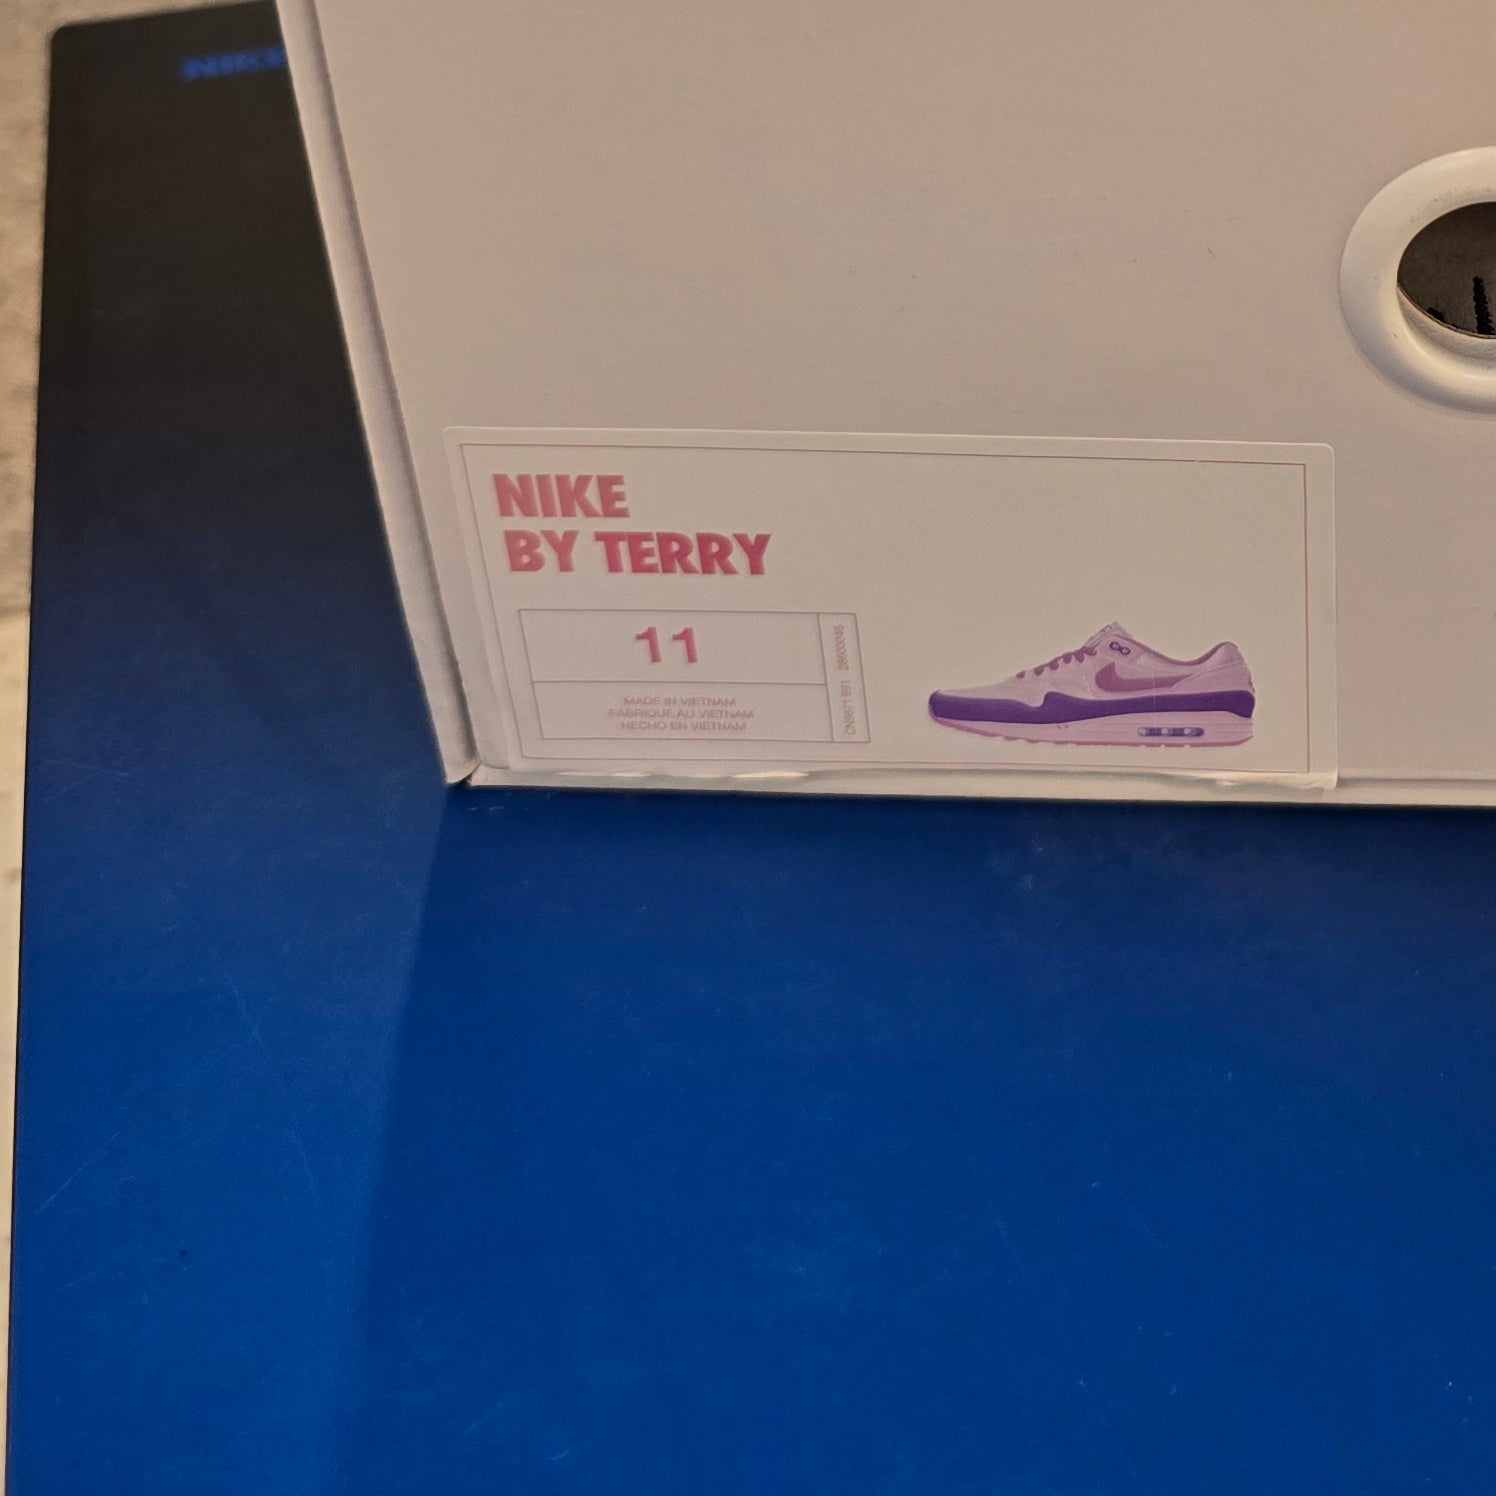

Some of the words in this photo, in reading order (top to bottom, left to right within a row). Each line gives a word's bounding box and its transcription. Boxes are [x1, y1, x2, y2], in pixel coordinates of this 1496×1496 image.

[492, 472, 631, 518] NIKE
[503, 529, 580, 573] BY
[594, 531, 774, 576] TERRY
[635, 626, 699, 663] 11
[608, 708, 673, 718] FABRIQUE
[676, 709, 695, 719] AU
[698, 709, 754, 719] VIETNAM
[623, 696, 661, 706] MADE
[664, 697, 677, 706] IN
[680, 697, 737, 707] VIETNAM
[621, 720, 667, 730] HECHO
[670, 721, 689, 731] EN
[692, 721, 747, 732] VIETNAM
